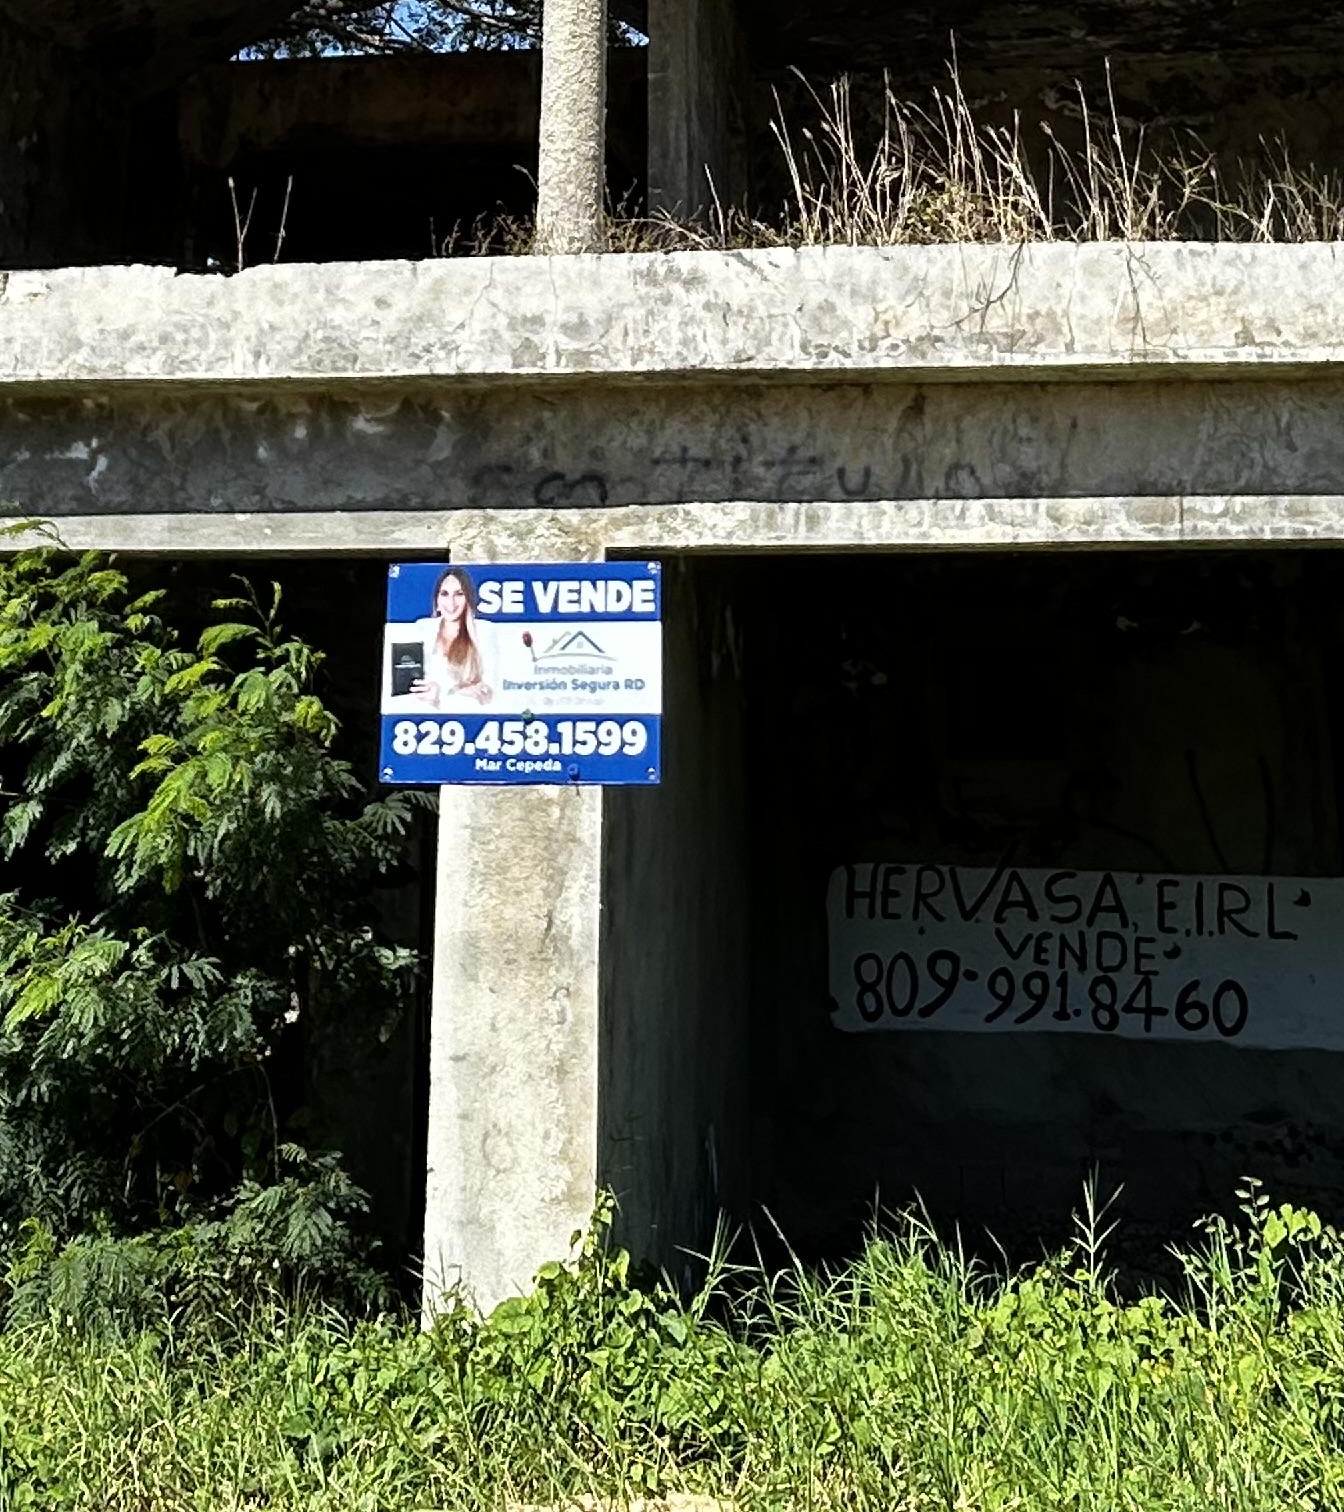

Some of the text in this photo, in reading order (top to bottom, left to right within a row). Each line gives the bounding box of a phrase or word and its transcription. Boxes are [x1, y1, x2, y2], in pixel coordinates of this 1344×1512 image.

[476, 579, 656, 614] SE VENDE
[533, 664, 614, 676] Inmobiliaria
[502, 677, 646, 694] Inversión Segura RD
[392, 719, 648, 756] 829.458.1599
[474, 757, 563, 774] Mar Cepeda
